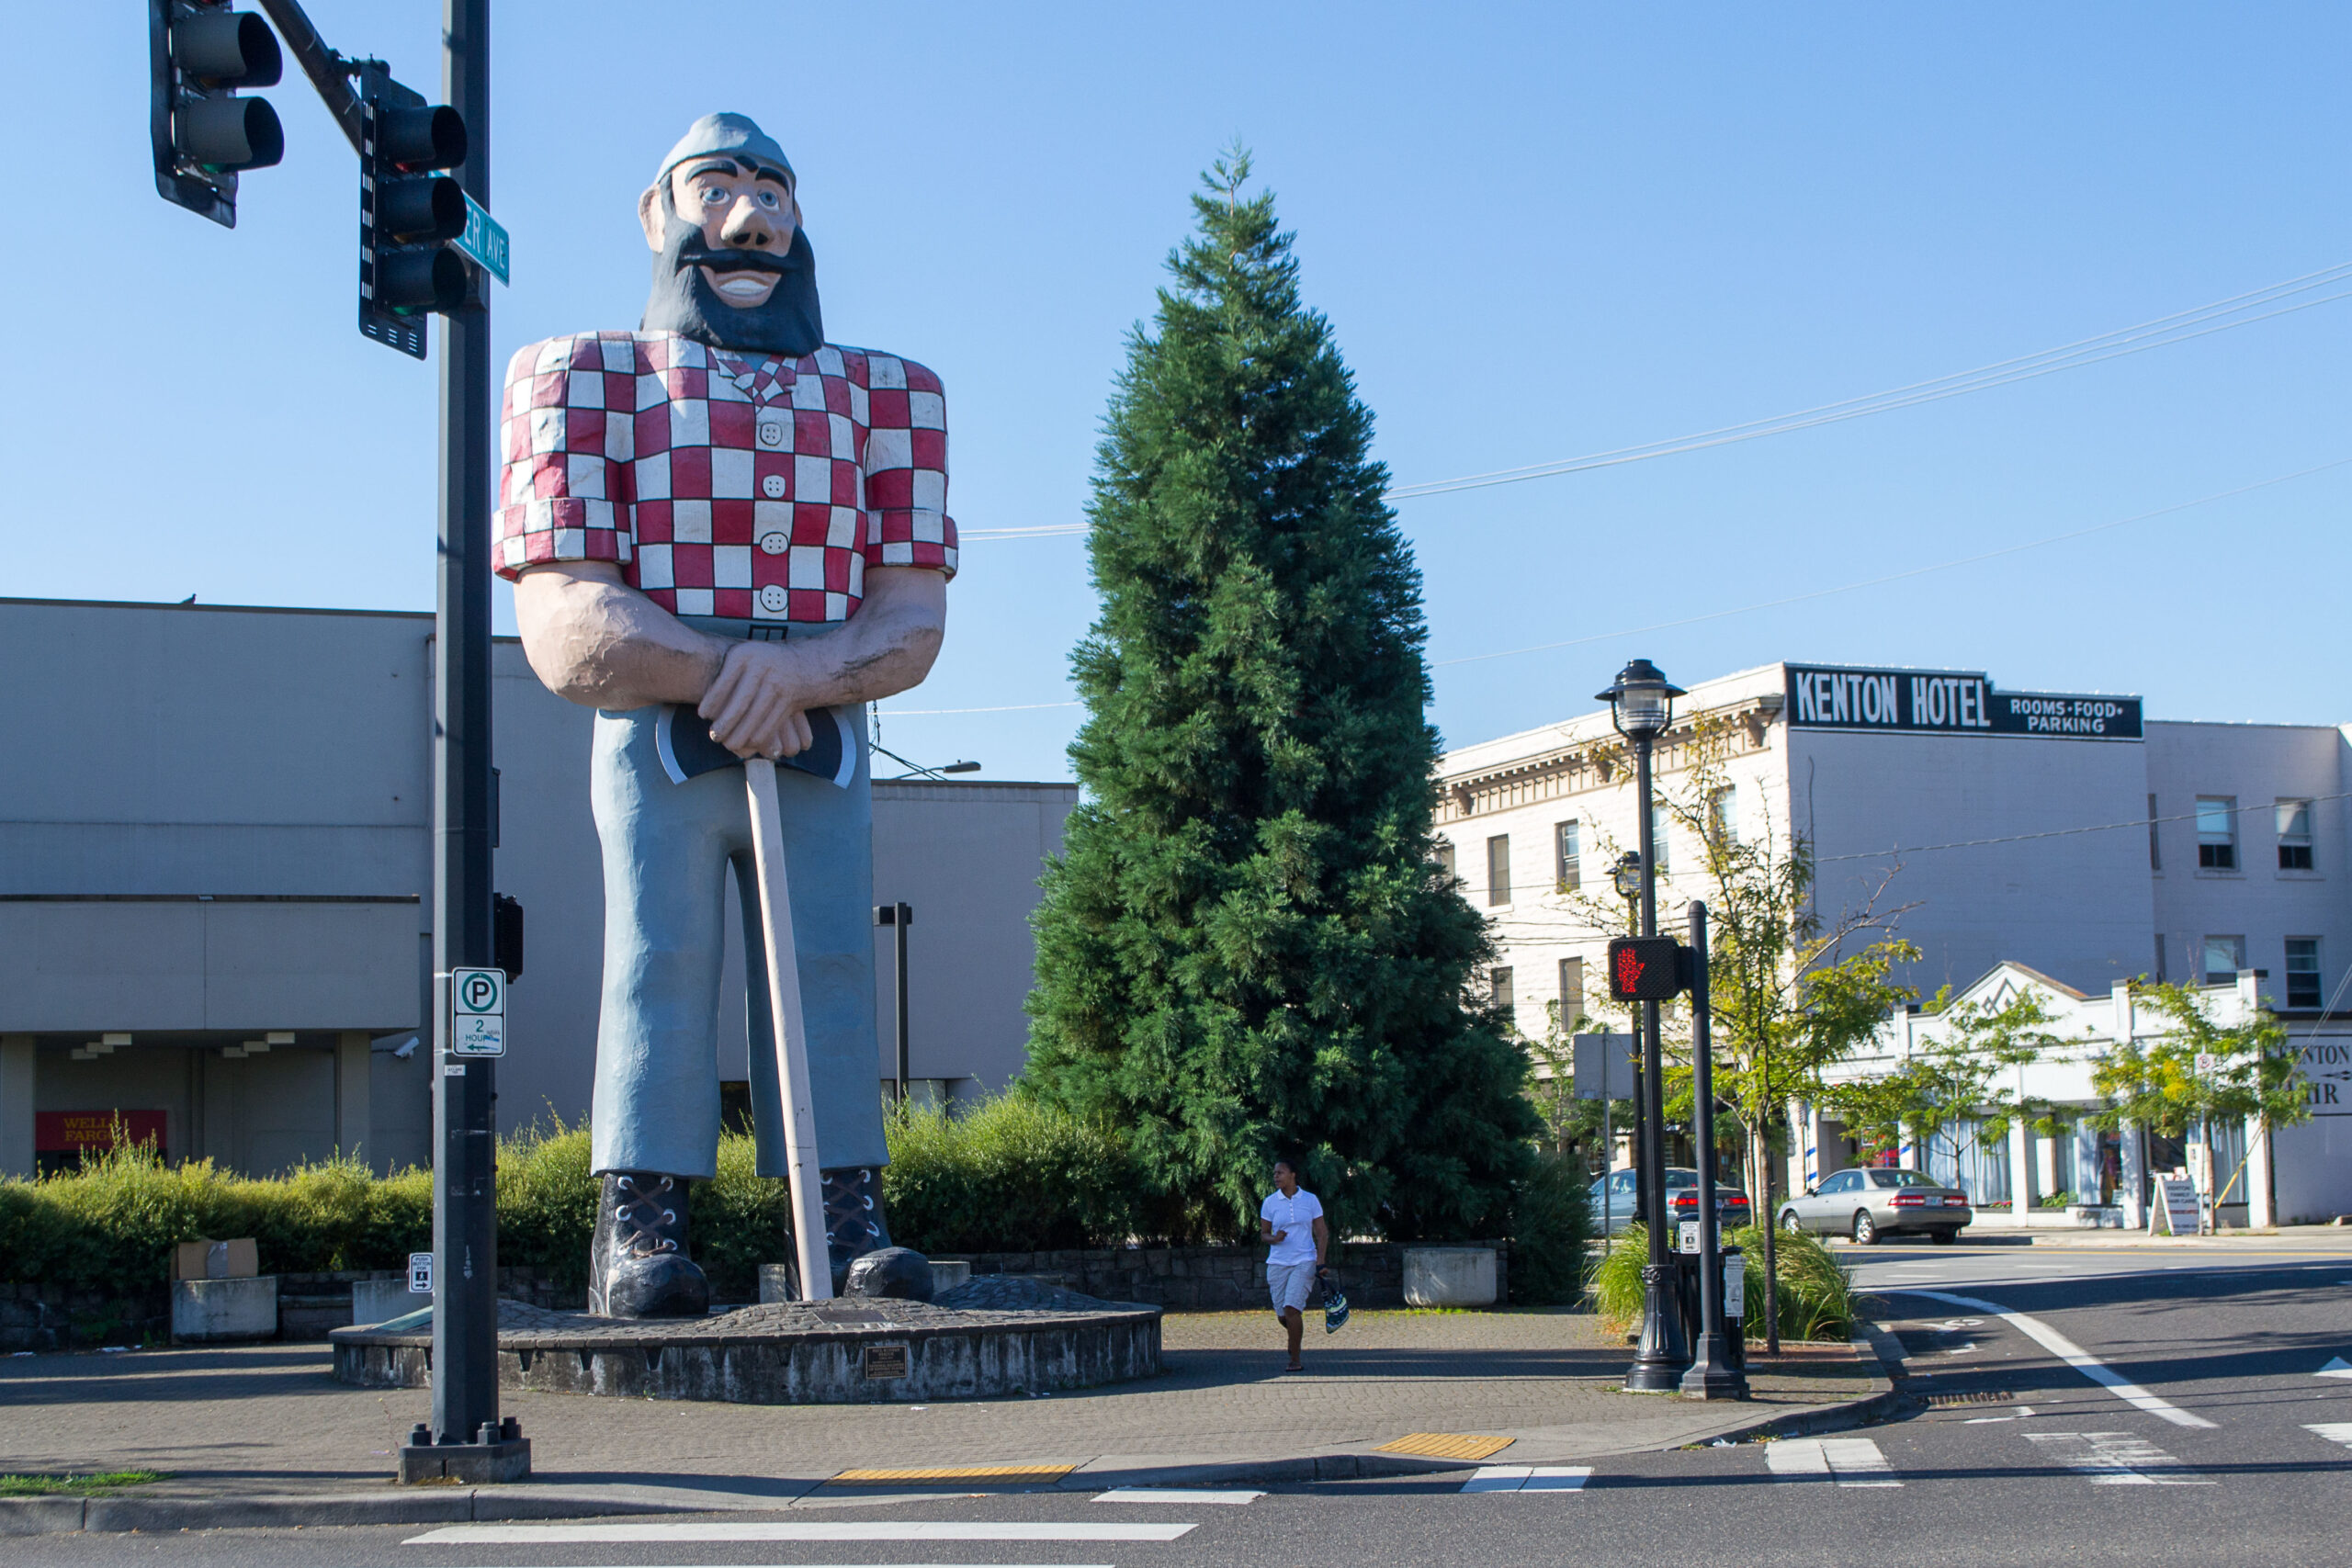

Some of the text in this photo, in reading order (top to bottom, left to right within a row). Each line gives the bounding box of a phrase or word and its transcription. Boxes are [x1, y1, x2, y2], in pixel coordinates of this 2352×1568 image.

[487, 229, 505, 269] AVE
[1796, 671, 1992, 728] KENTON HOTEL
[2028, 716, 2105, 734] PARKING
[472, 981, 490, 1005] P
[476, 1019, 484, 1032] 2
[63, 1117, 114, 1129] WELL
[64, 1130, 113, 1142] FARG
